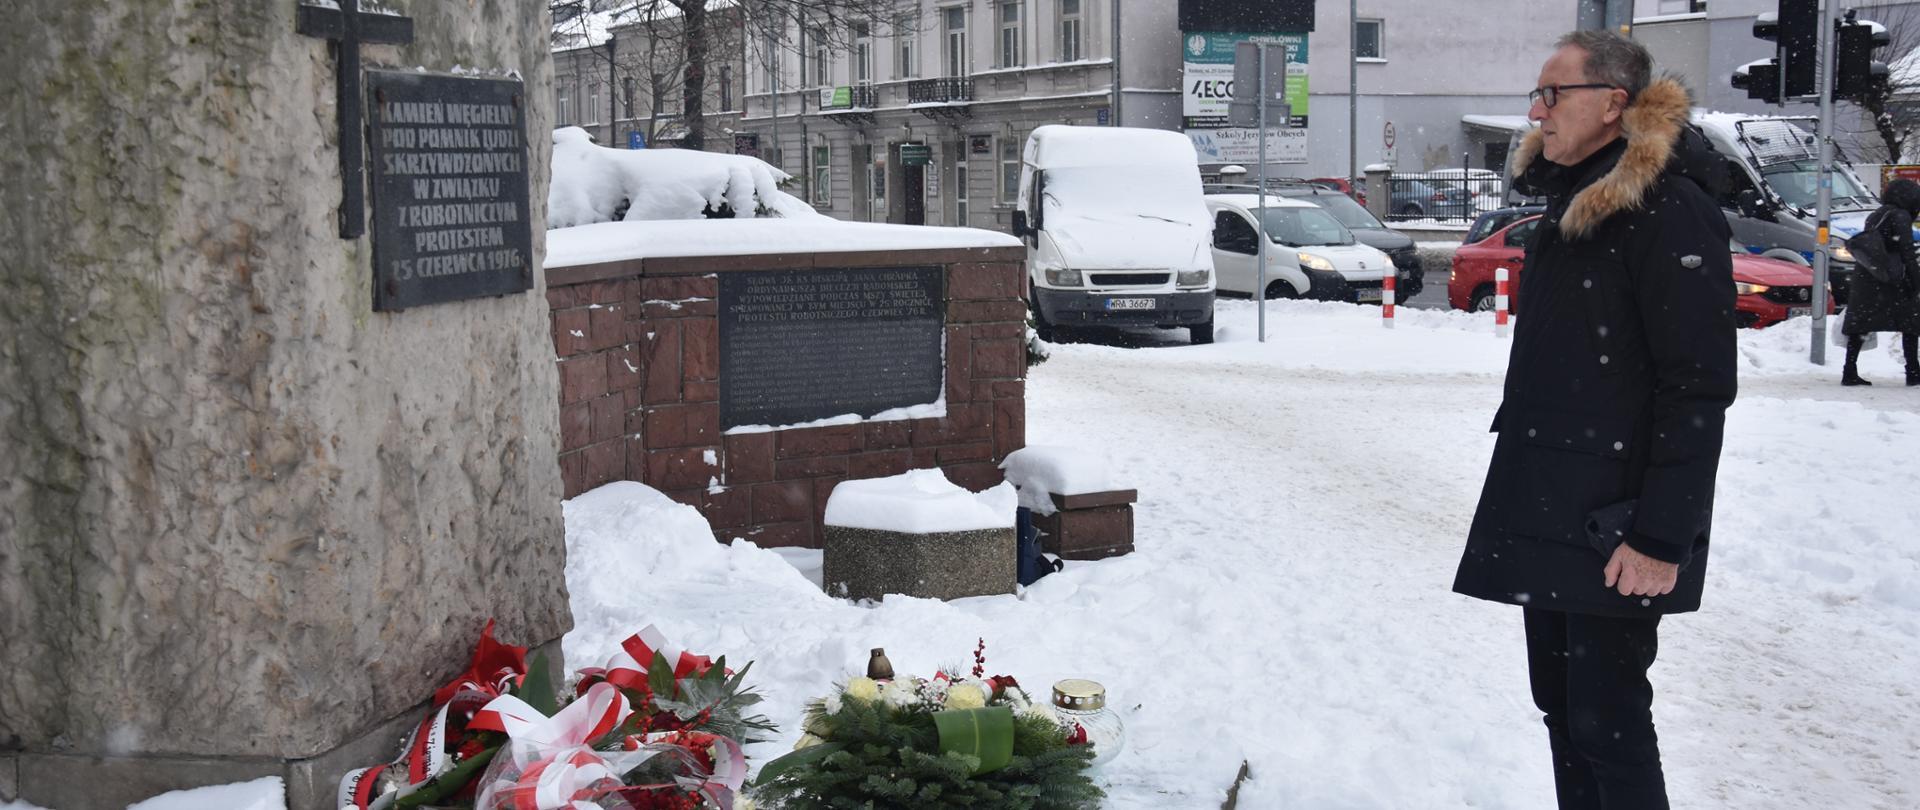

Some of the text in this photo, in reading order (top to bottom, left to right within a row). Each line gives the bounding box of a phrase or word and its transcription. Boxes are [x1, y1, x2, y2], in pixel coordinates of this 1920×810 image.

[447, 103, 516, 128] WĘGIELNY
[383, 128, 519, 152] POD POMNIK LUDZI
[1216, 130, 1305, 141] Szkoły Języów Obcych
[383, 152, 521, 176] SKRZYWDZONYCH
[413, 177, 500, 201] W ZWIĄZKU
[399, 202, 518, 227] Z ROBOTNICZYM
[415, 226, 504, 253] PROTESTEM
[416, 252, 486, 278] CZERWCA
[855, 272, 876, 282] JANA
[863, 280, 919, 291] RADOMSKIEJ
[729, 302, 793, 314] SPRAWOWANEJ
[795, 302, 803, 311] W
[807, 301, 827, 311] TYM
[830, 299, 867, 310] MIEJSCU
[869, 299, 876, 308] W
[739, 291, 817, 304] WYPOWIEDZIANE
[820, 290, 860, 302] PODCZAS
[863, 290, 885, 301] MSZY
[1110, 298, 1155, 309] WRA 36673
[738, 311, 787, 323] PROTESTU
[790, 309, 858, 321] ROBOTNICZEGO
[861, 307, 905, 318] CZERWIEC
